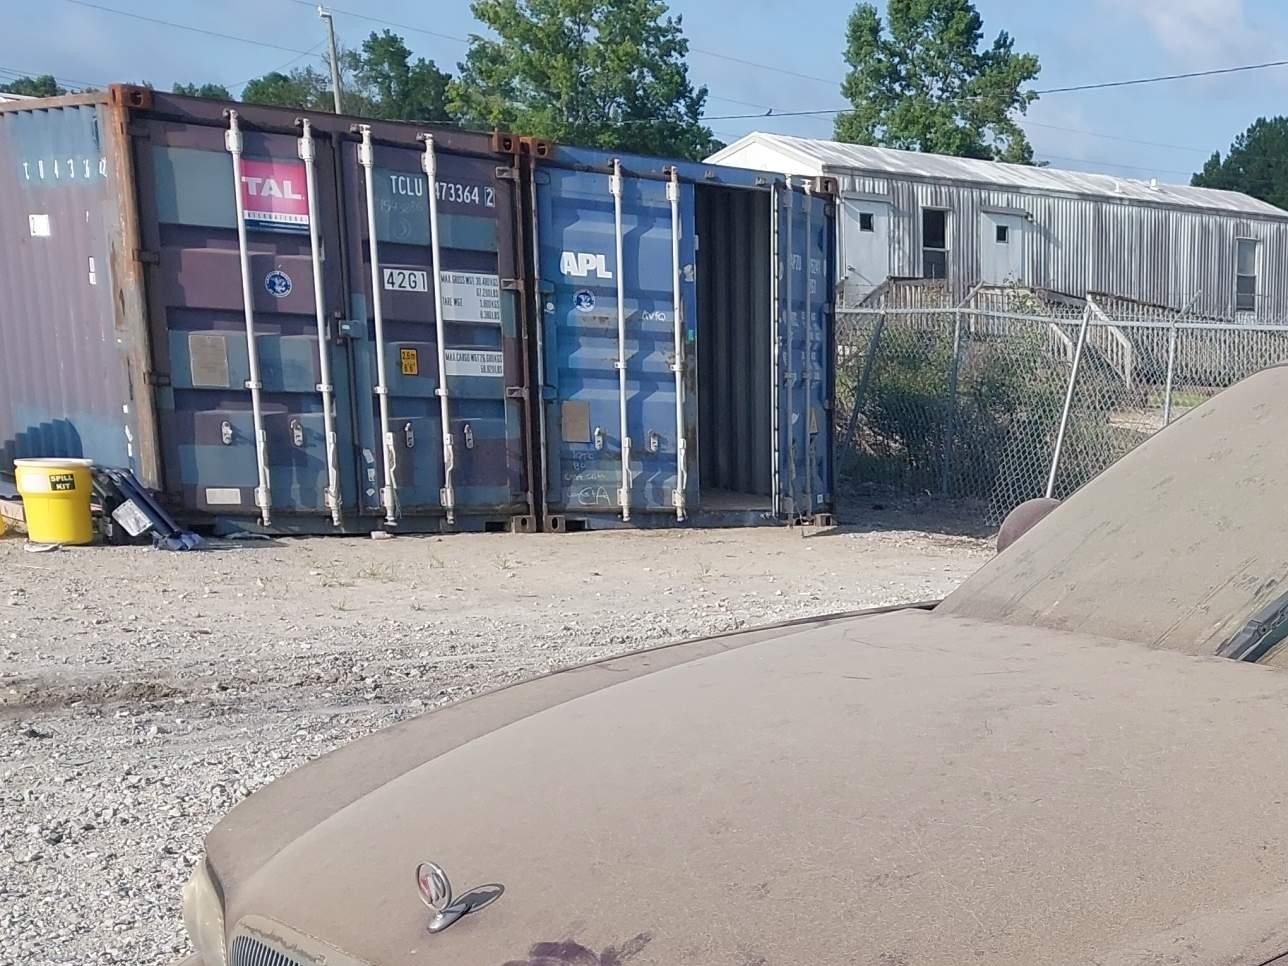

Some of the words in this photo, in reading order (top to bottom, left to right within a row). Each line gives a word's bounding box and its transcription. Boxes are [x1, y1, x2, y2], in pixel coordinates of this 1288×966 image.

[241, 176, 302, 200] TAL
[390, 175, 423, 197] TCLU
[485, 187, 494, 207] 2
[560, 251, 614, 280] APL
[386, 271, 426, 290] 42G1
[50, 474, 74, 482] SPILL
